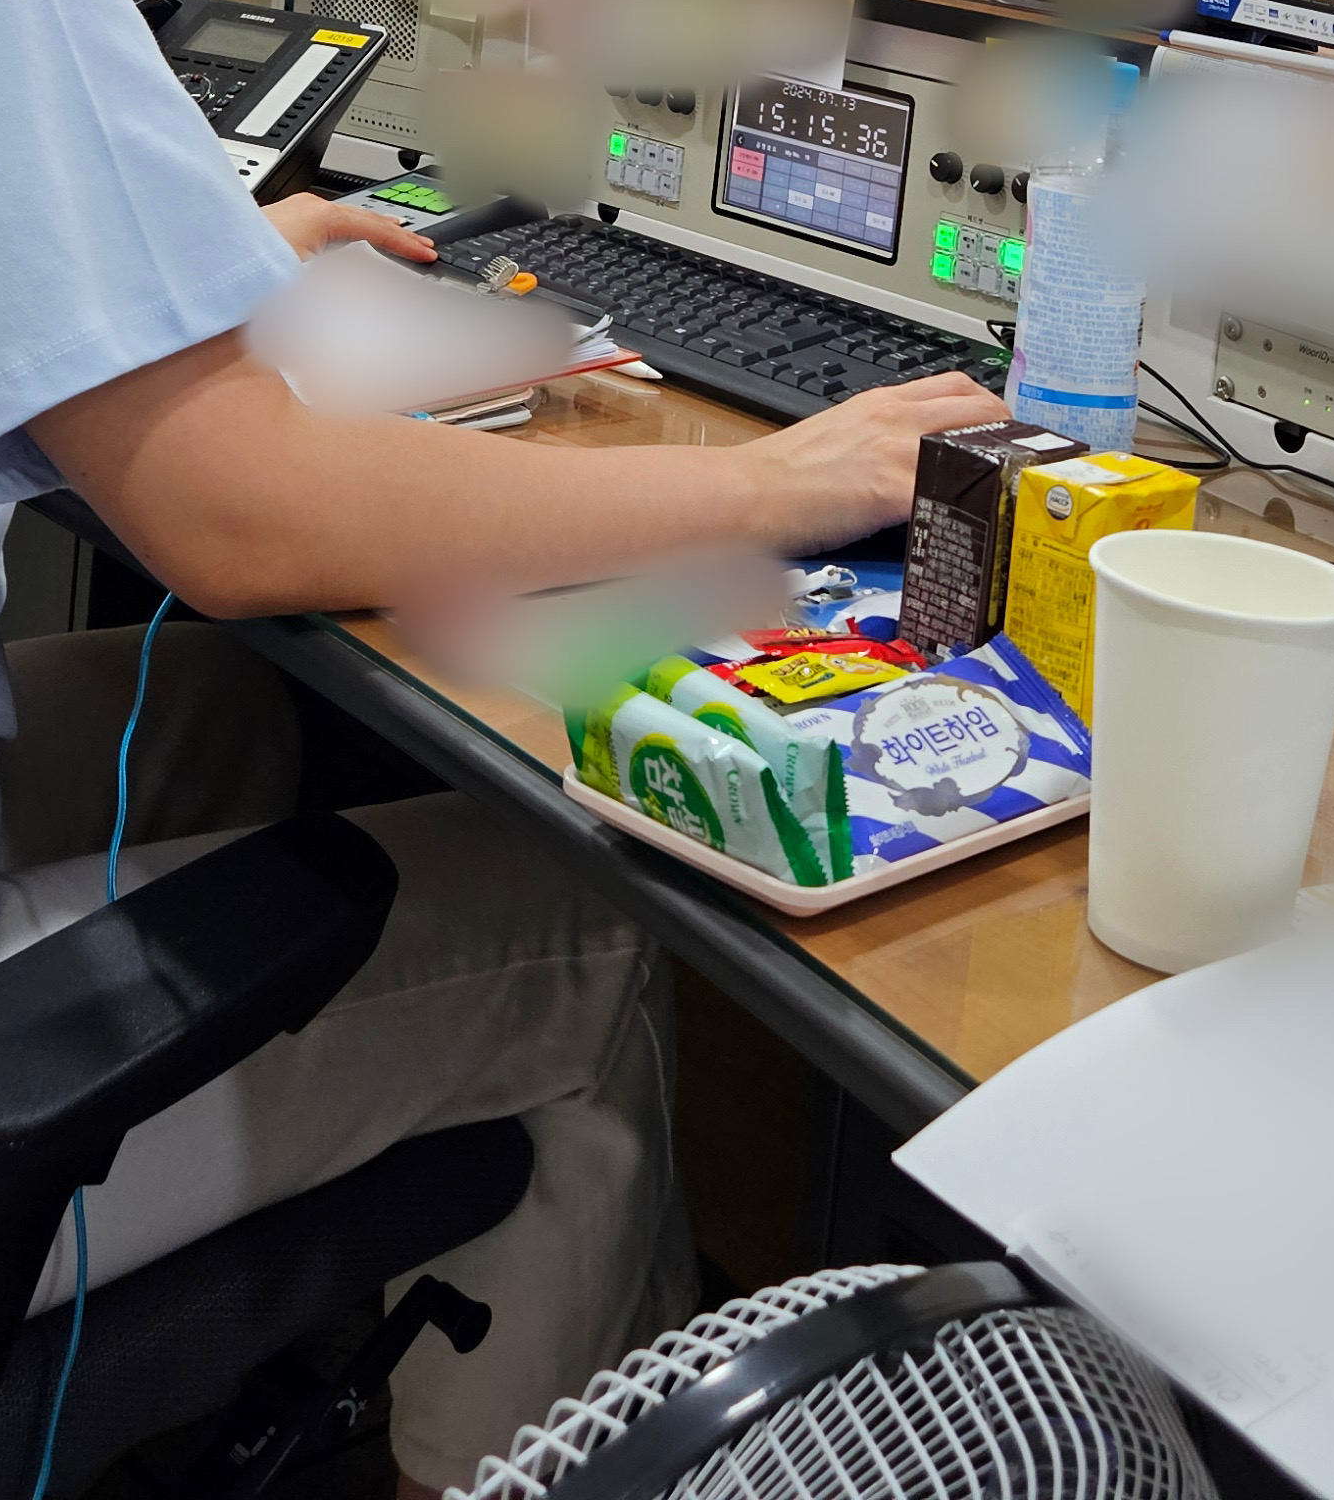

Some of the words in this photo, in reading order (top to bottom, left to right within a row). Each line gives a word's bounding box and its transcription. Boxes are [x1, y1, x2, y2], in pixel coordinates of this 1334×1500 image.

[240, 12, 276, 24] SAMSUNG
[782, 83, 857, 112] 2024.07.13
[758, 102, 888, 159] 15:15:36
[793, 711, 832, 733] ROWN
[881, 706, 1000, 767] 화이트하임
[726, 768, 746, 828] CROWN
